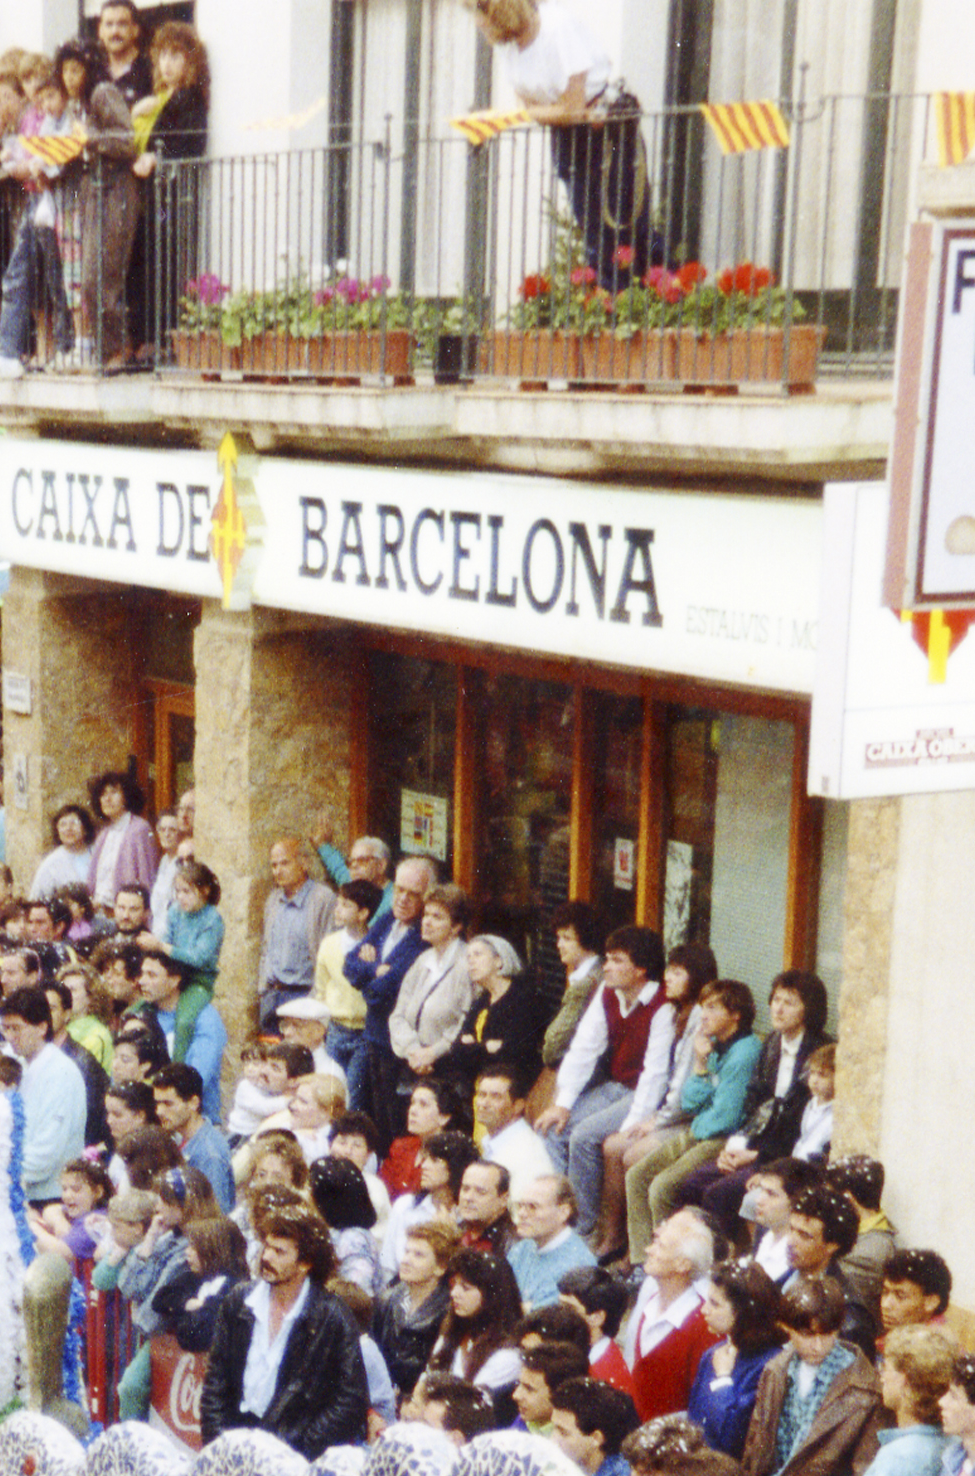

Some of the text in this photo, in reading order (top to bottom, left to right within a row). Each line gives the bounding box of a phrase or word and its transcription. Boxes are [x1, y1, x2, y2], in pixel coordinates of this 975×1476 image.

[12, 467, 664, 629] CAIXA DE BARCELONA
[686, 604, 769, 644] ESTALVIS
